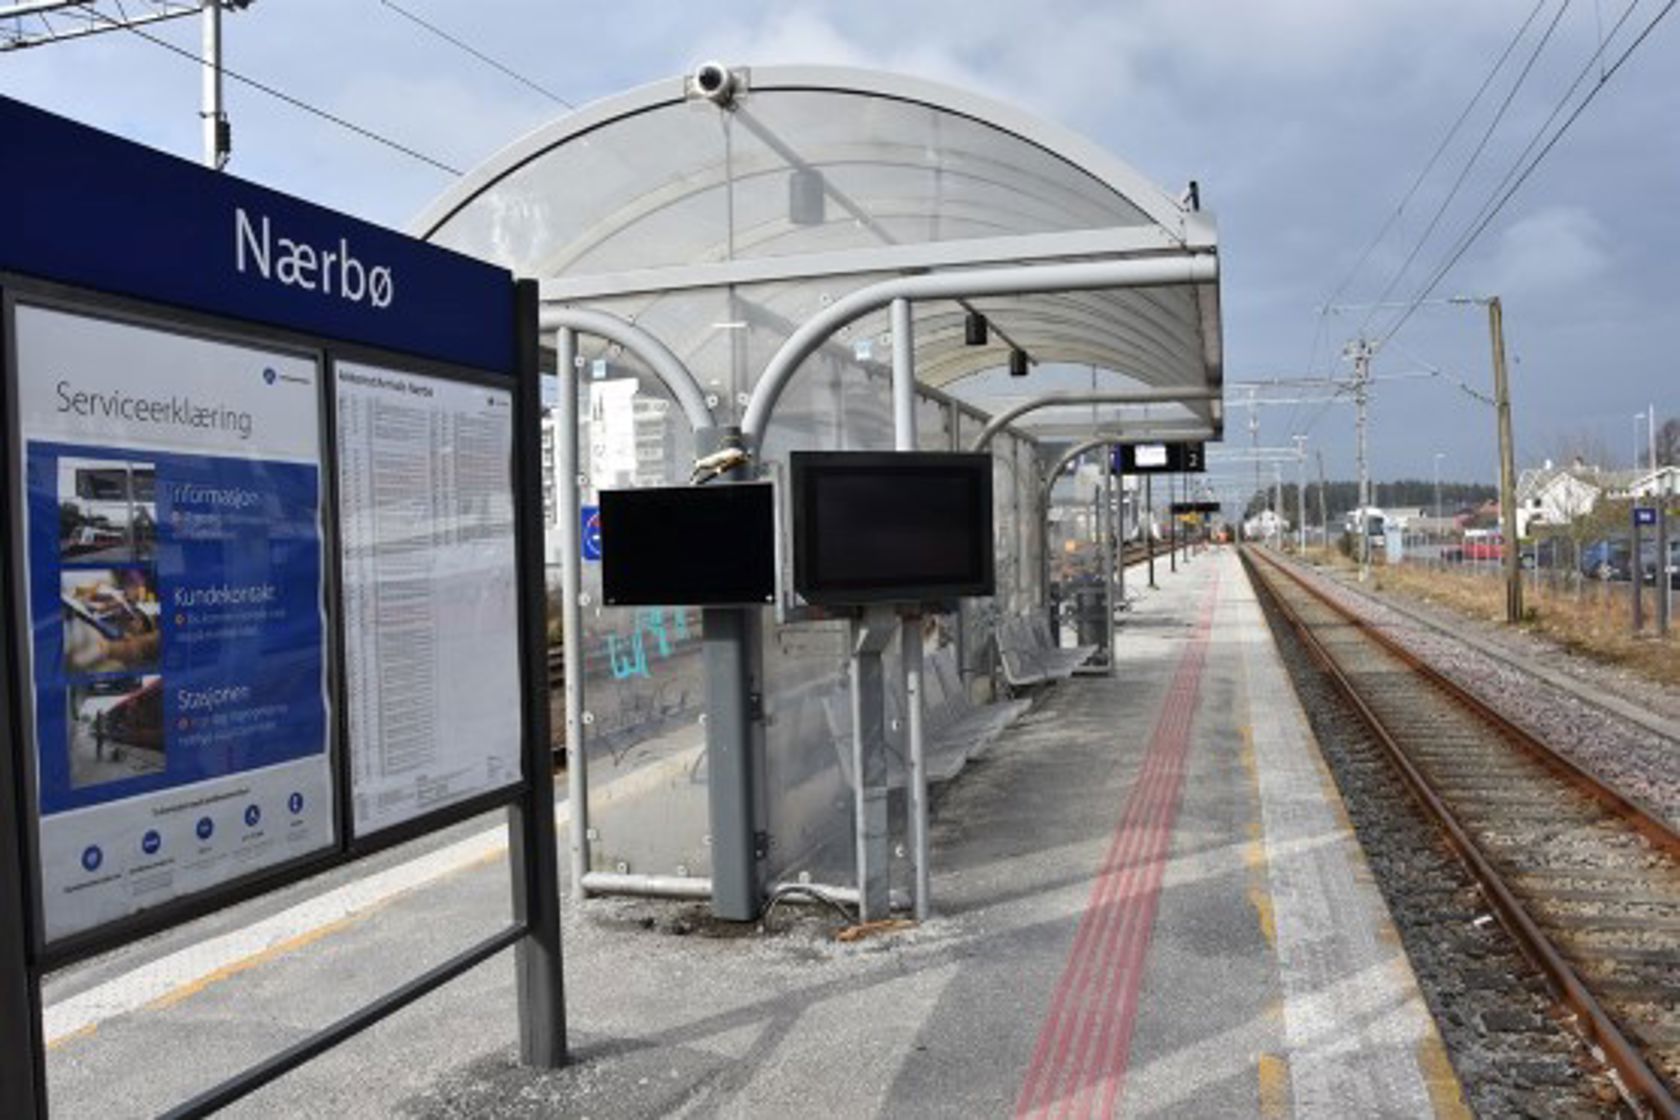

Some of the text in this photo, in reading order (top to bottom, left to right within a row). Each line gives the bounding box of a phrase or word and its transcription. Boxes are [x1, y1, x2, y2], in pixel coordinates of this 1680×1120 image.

[235, 207, 394, 308] Nærbø
[56, 380, 252, 440] Serviceerklæring
[172, 482, 259, 509] nformasjon
